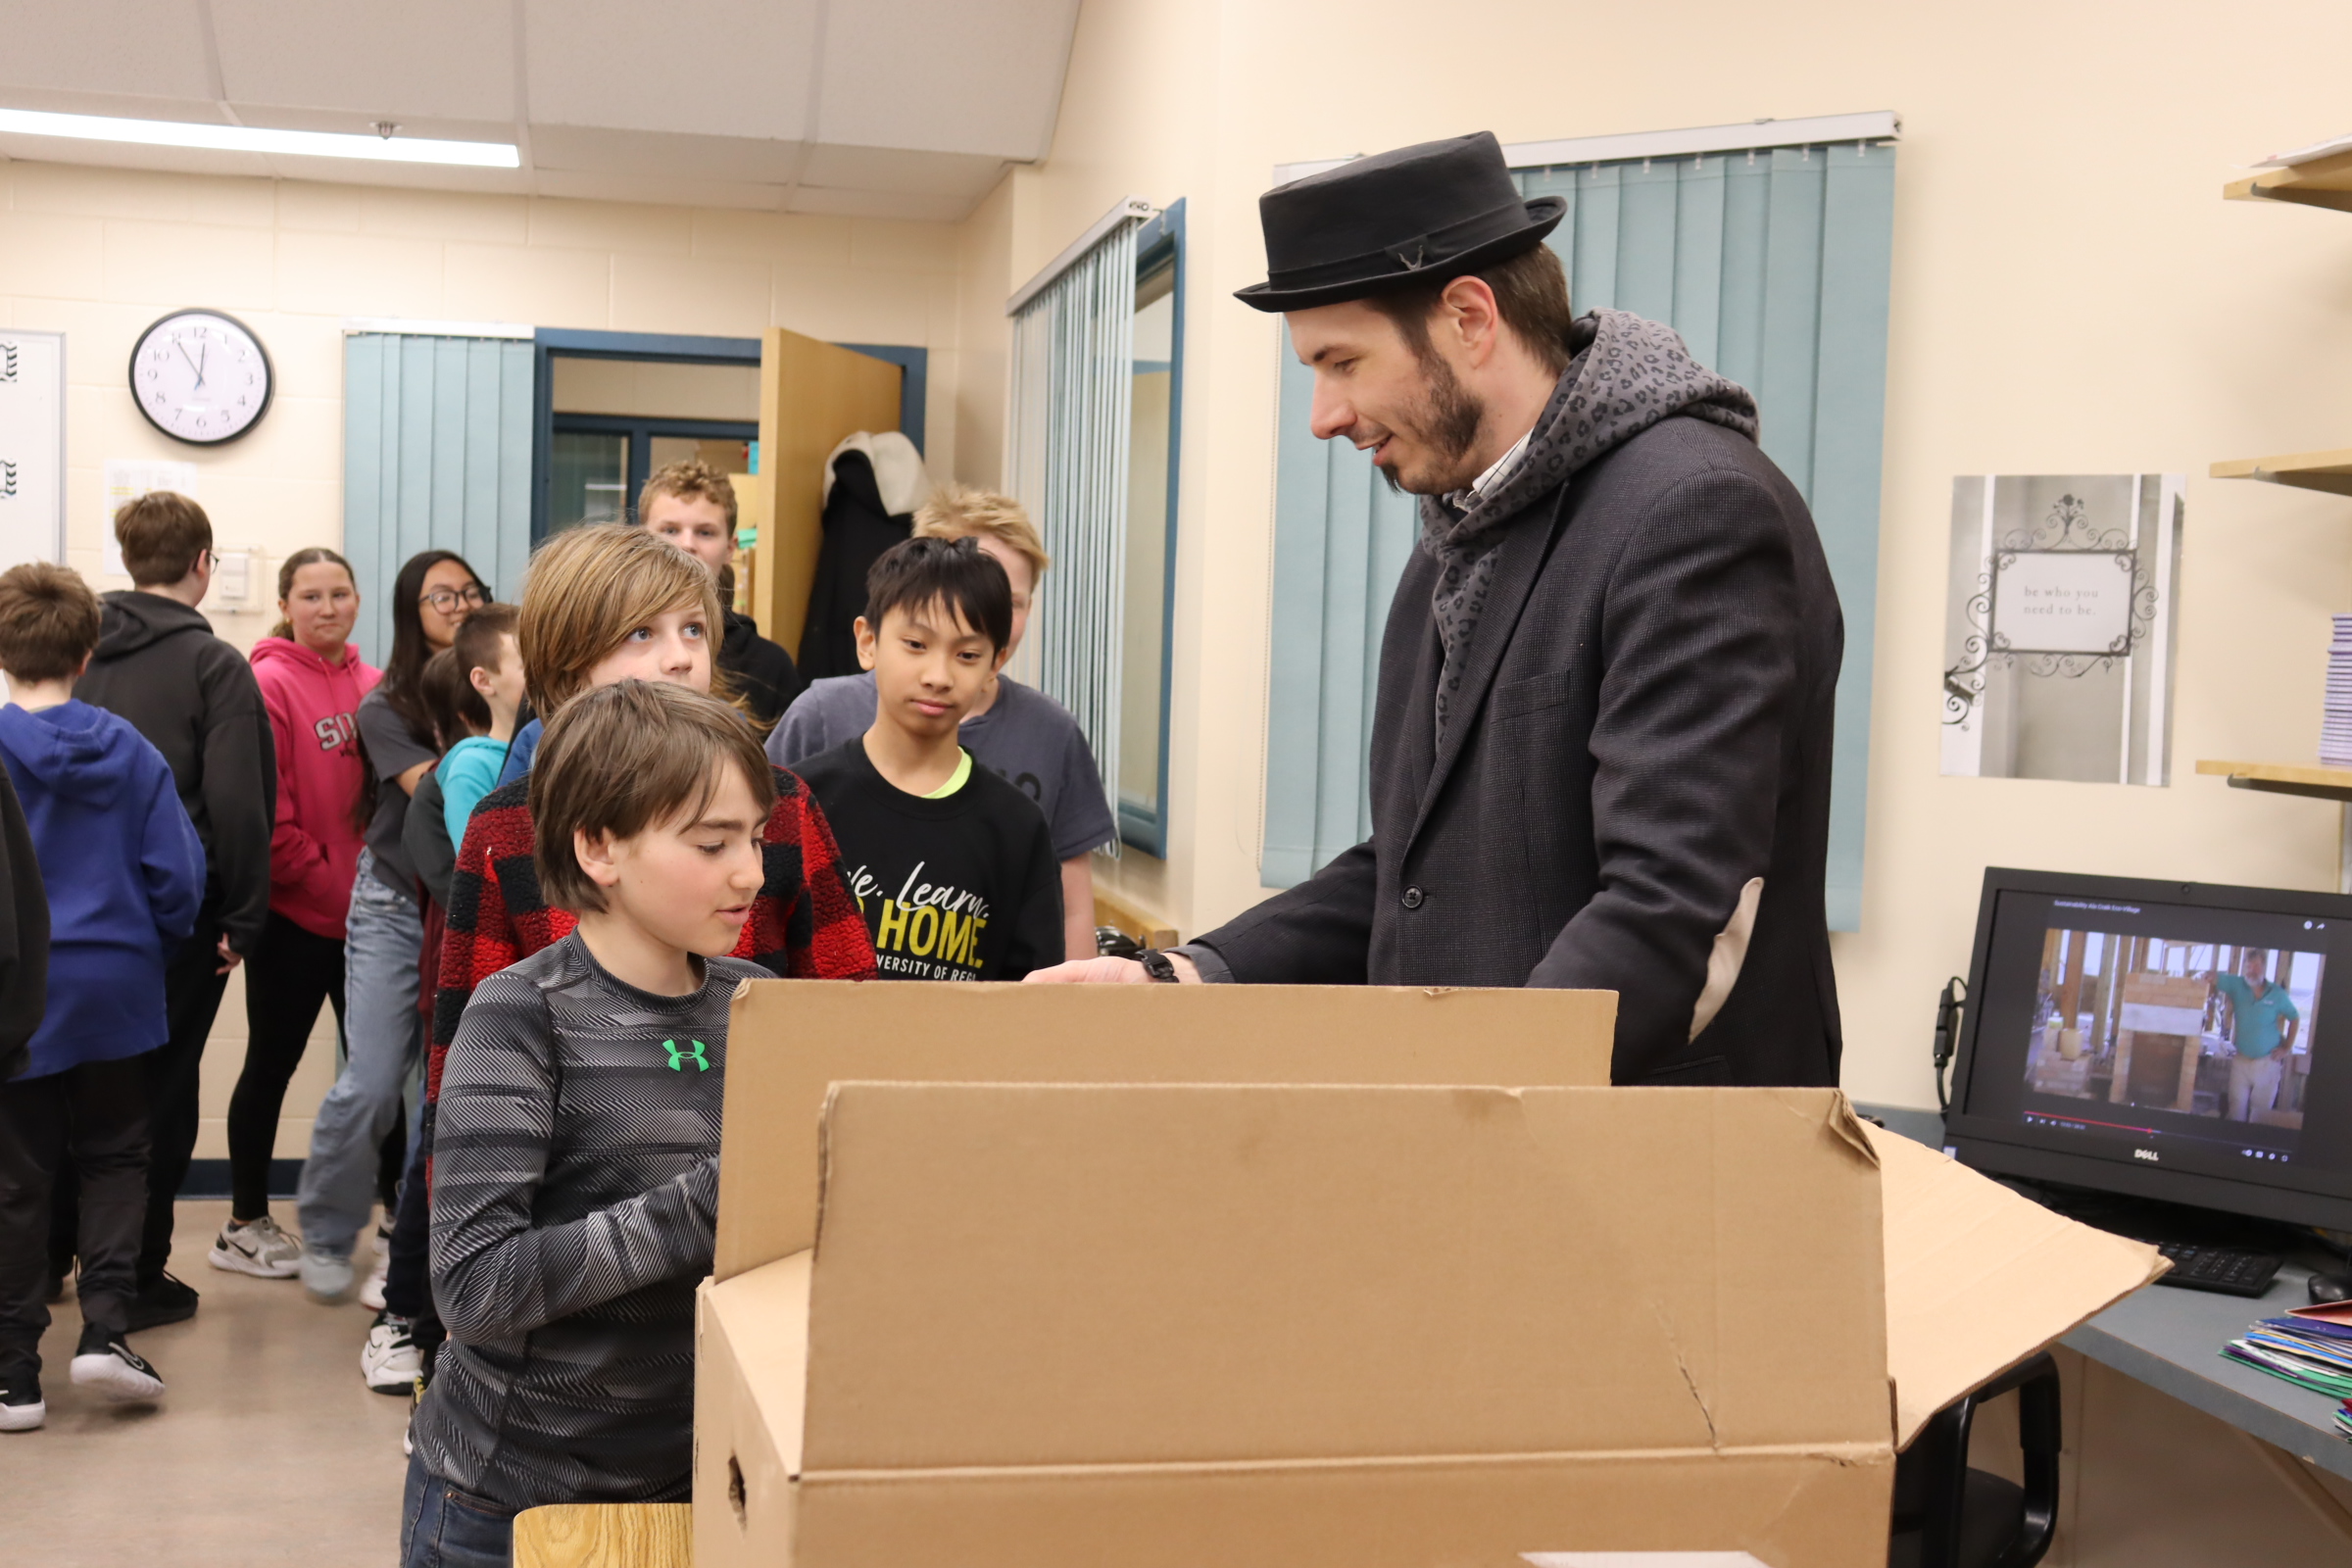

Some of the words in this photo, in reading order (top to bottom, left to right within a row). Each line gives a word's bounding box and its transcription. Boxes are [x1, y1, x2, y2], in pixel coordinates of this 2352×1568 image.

[193, 326, 207, 338] 12
[153, 349, 170, 362] 10
[237, 349, 246, 363] 2
[147, 368, 158, 381] 9
[245, 372, 254, 385] 3
[155, 392, 166, 404] 8
[237, 394, 246, 407] 4
[174, 408, 182, 420] 7
[220, 410, 230, 422] 5
[196, 416, 207, 428] 6
[2024, 585, 2038, 597] be
[2044, 585, 2071, 597] who
[2076, 590, 2099, 602] you
[2024, 604, 2054, 615] need
[2059, 606, 2073, 615] to
[2077, 604, 2096, 615] be.
[846, 864, 884, 897] ve.
[896, 860, 990, 919] Learn.
[875, 898, 988, 969] HOME.
[876, 954, 931, 977] VERSITY
[933, 964, 949, 980] OF
[2133, 1148, 2160, 1161] DELL
